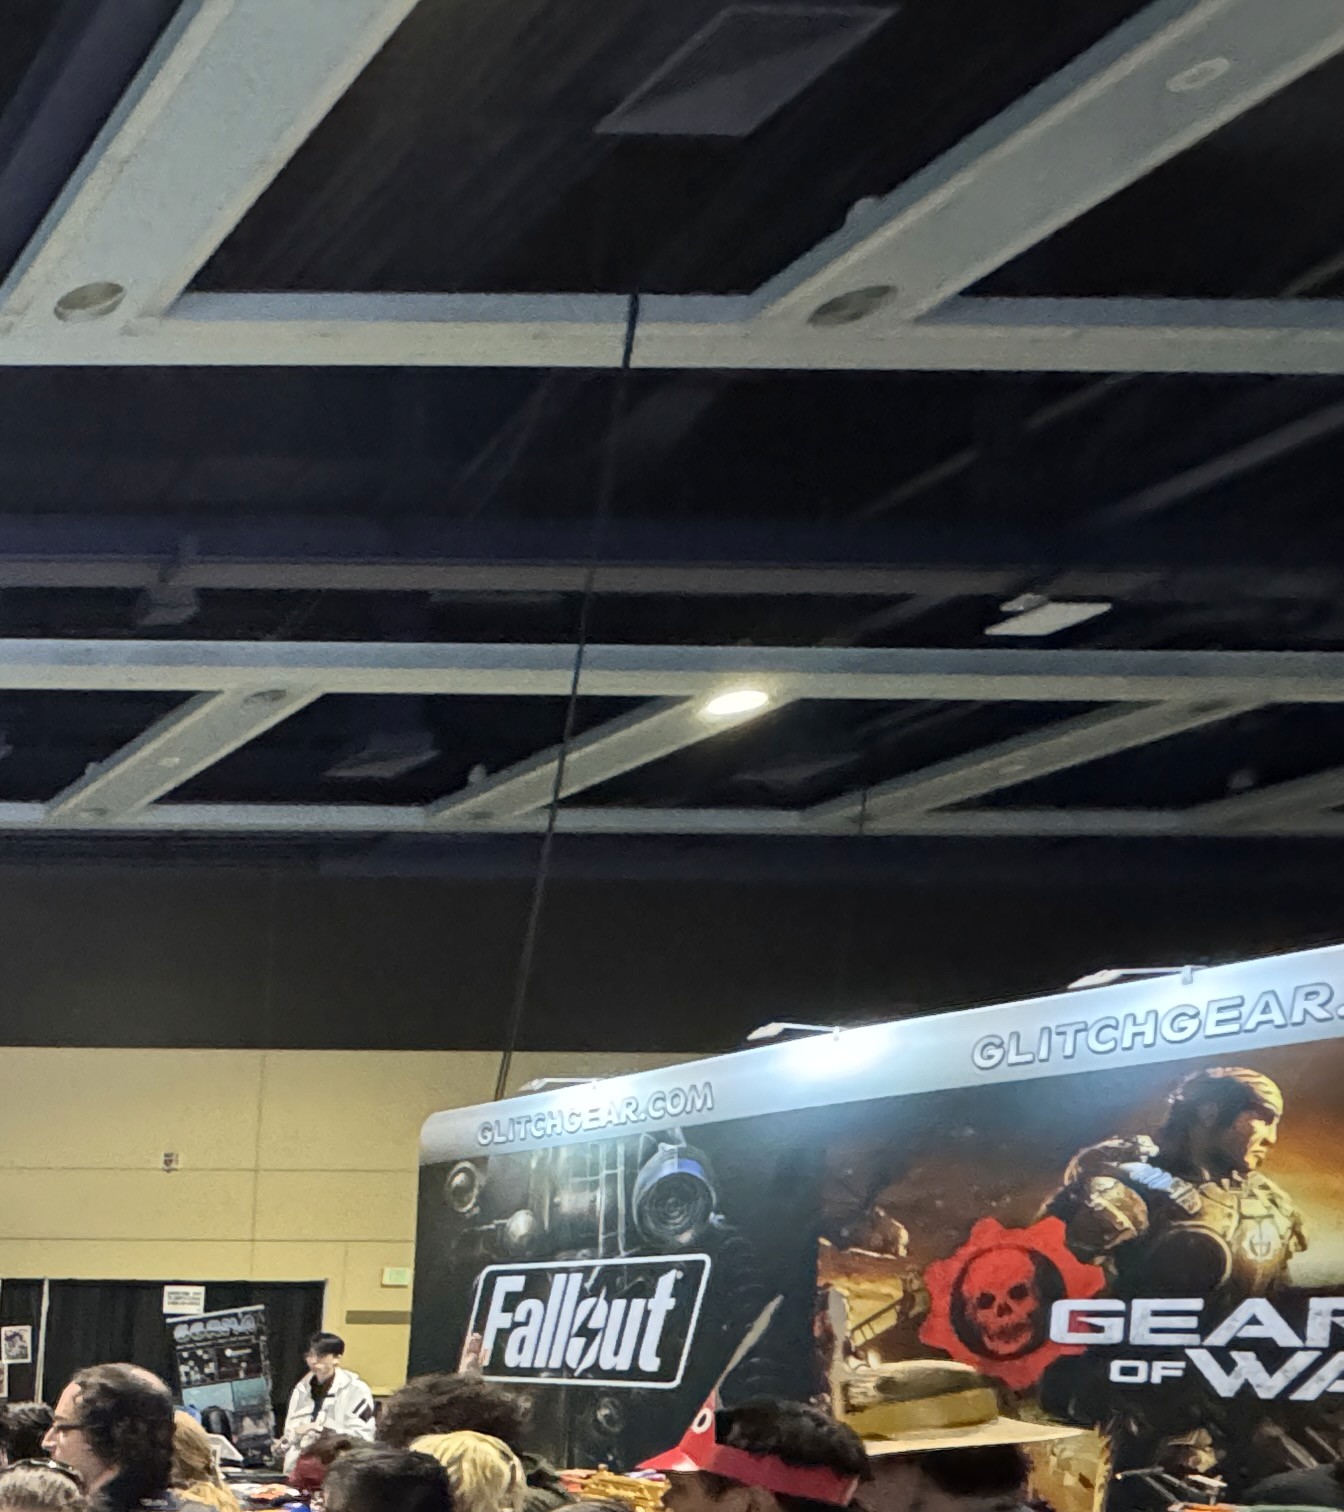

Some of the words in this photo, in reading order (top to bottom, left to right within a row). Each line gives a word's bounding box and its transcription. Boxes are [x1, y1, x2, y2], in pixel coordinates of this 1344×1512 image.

[477, 1082, 714, 1146] GLITCHGEAR.COM
[482, 1268, 677, 1378] Fallout
[1109, 1359, 1186, 1384] OF
